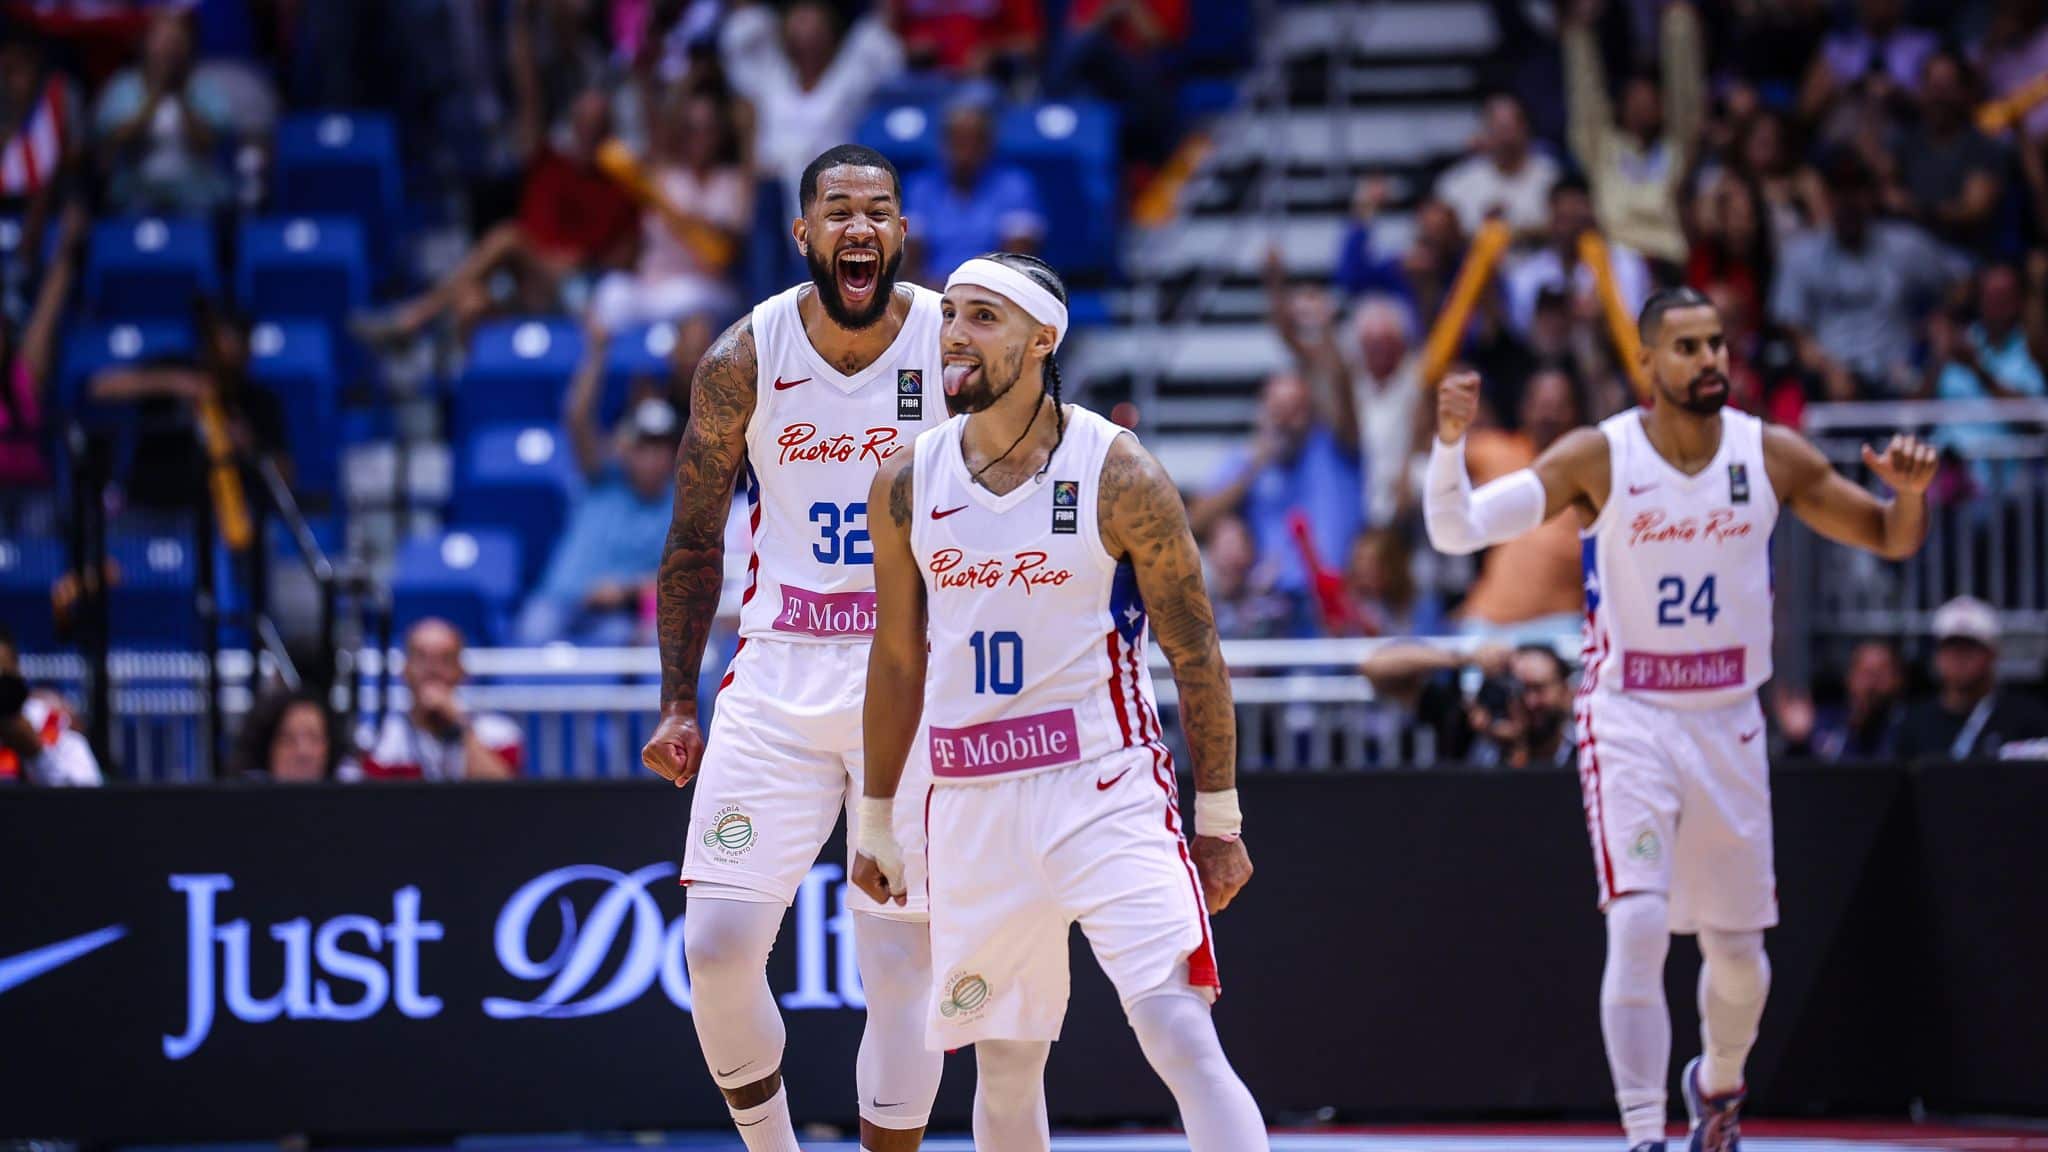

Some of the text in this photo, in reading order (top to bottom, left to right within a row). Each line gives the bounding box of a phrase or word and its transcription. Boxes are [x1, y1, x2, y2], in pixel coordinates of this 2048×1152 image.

[901, 398, 919, 408] FIBA
[777, 423, 904, 467] Puerto Ri
[808, 501, 874, 565] 32
[1628, 506, 1752, 548] Puerto Rico
[929, 548, 1073, 596] Puerto Rico
[807, 602, 877, 632] Mobi
[1657, 573, 1719, 627] 24
[969, 630, 1023, 695] 10
[1656, 654, 1738, 688] Mobile
[961, 724, 1068, 768] Mobile
[162, 873, 445, 1060] Just
[779, 864, 867, 1010] It
